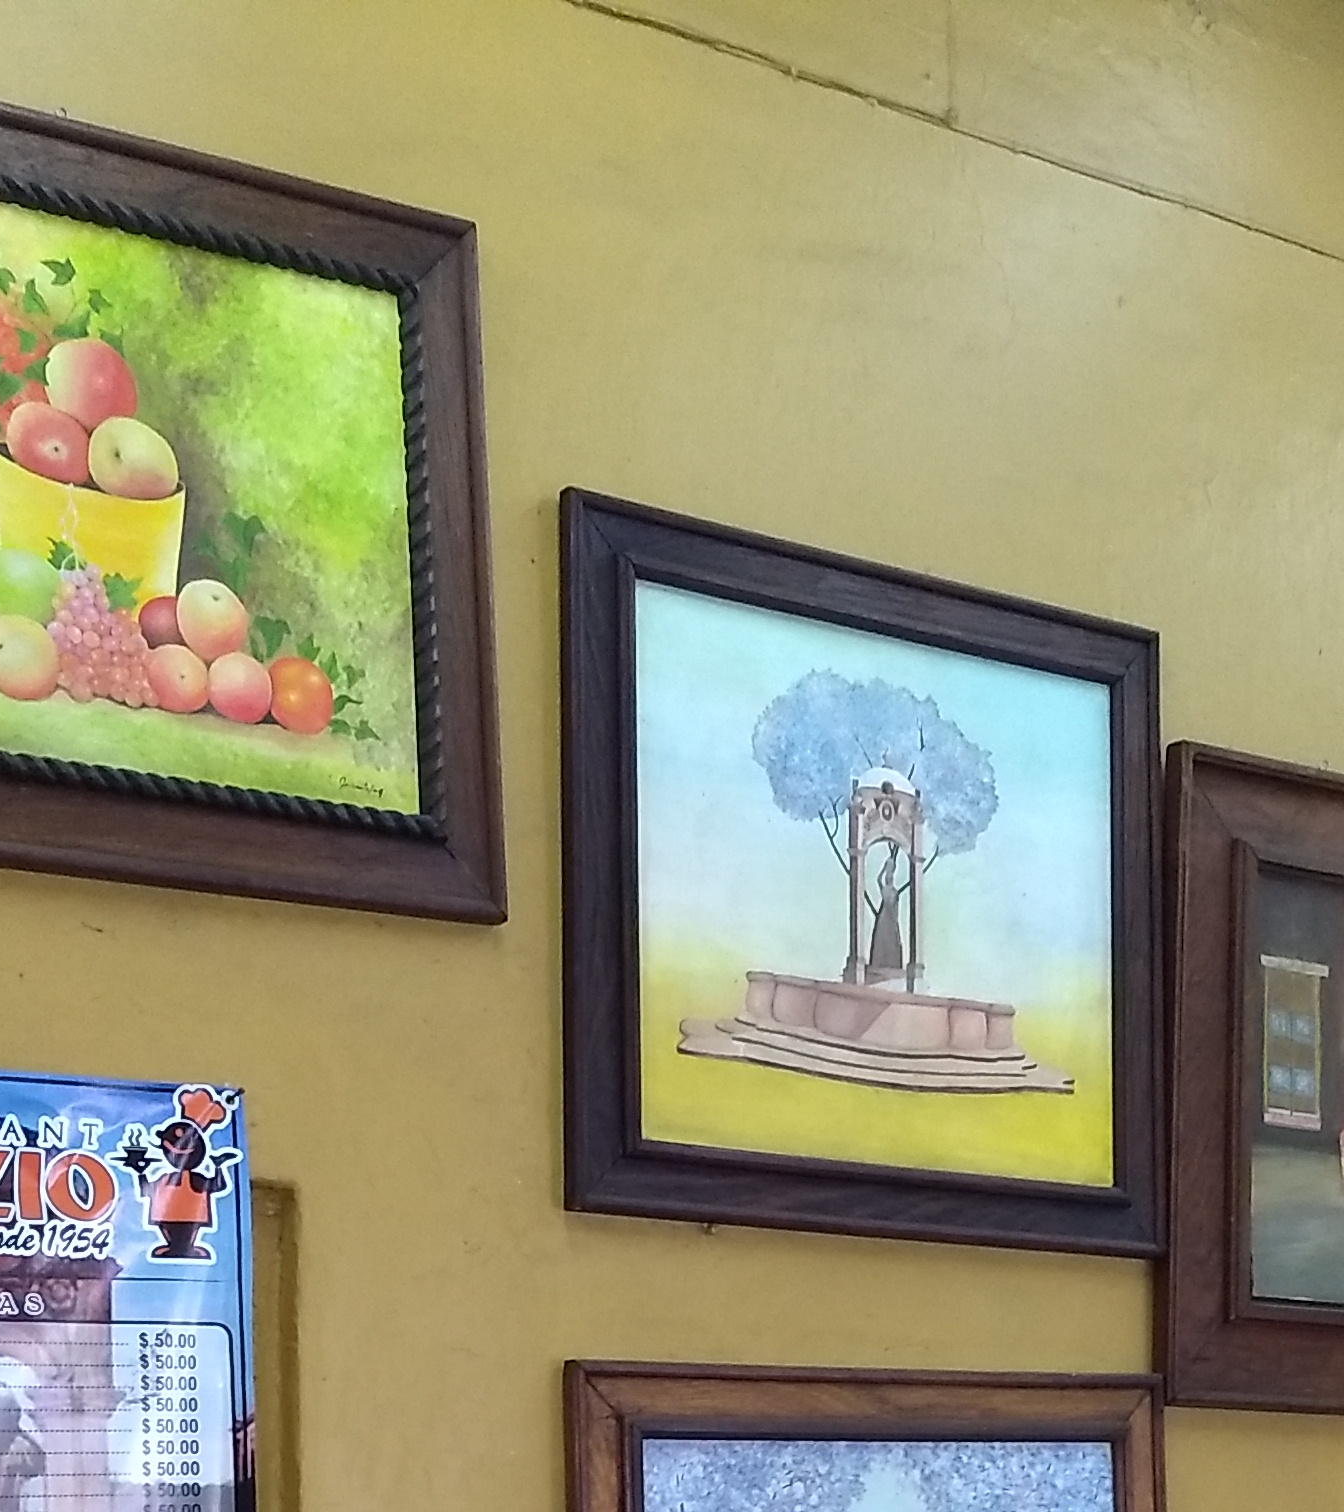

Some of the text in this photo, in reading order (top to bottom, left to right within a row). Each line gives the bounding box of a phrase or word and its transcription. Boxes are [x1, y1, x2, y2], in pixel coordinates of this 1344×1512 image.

[47, 1223, 110, 1253] 1954
[139, 1332, 149, 1348] $
[155, 1332, 196, 1348] 50.00
[139, 1353, 150, 1370] $
[155, 1354, 197, 1370] 50.00
[141, 1374, 150, 1391] $
[156, 1376, 197, 1391] 50.00
[141, 1396, 151, 1412] $
[156, 1397, 198, 1412] 50.00
[142, 1418, 151, 1434] $
[156, 1418, 199, 1434] 50.00
[142, 1439, 151, 1455] $
[156, 1440, 200, 1455] 50.00
[142, 1461, 151, 1477] $
[157, 1461, 200, 1476] 50.00
[142, 1482, 151, 1498] $
[157, 1482, 201, 1498] 50.00
